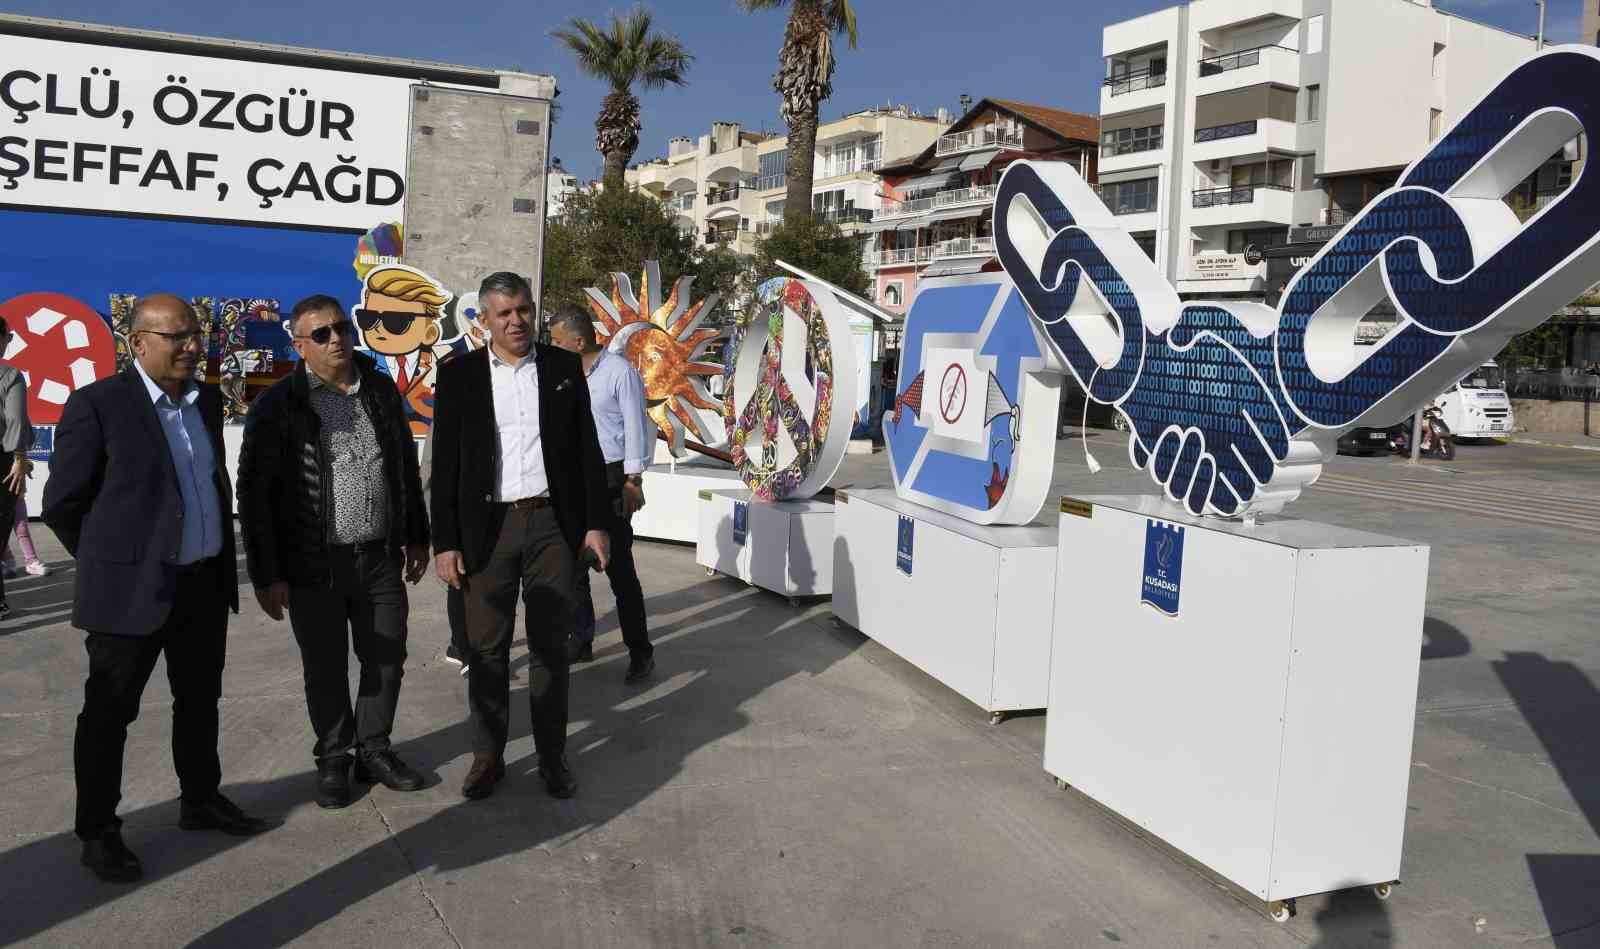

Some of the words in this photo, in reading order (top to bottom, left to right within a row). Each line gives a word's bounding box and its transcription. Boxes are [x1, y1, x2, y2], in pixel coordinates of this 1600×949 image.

[0, 67, 134, 129] ÇLÜ,
[153, 75, 355, 142] ÖZGÜR
[0, 136, 229, 202] ŞEFFAF,
[247, 154, 405, 209] ÇAĞD
